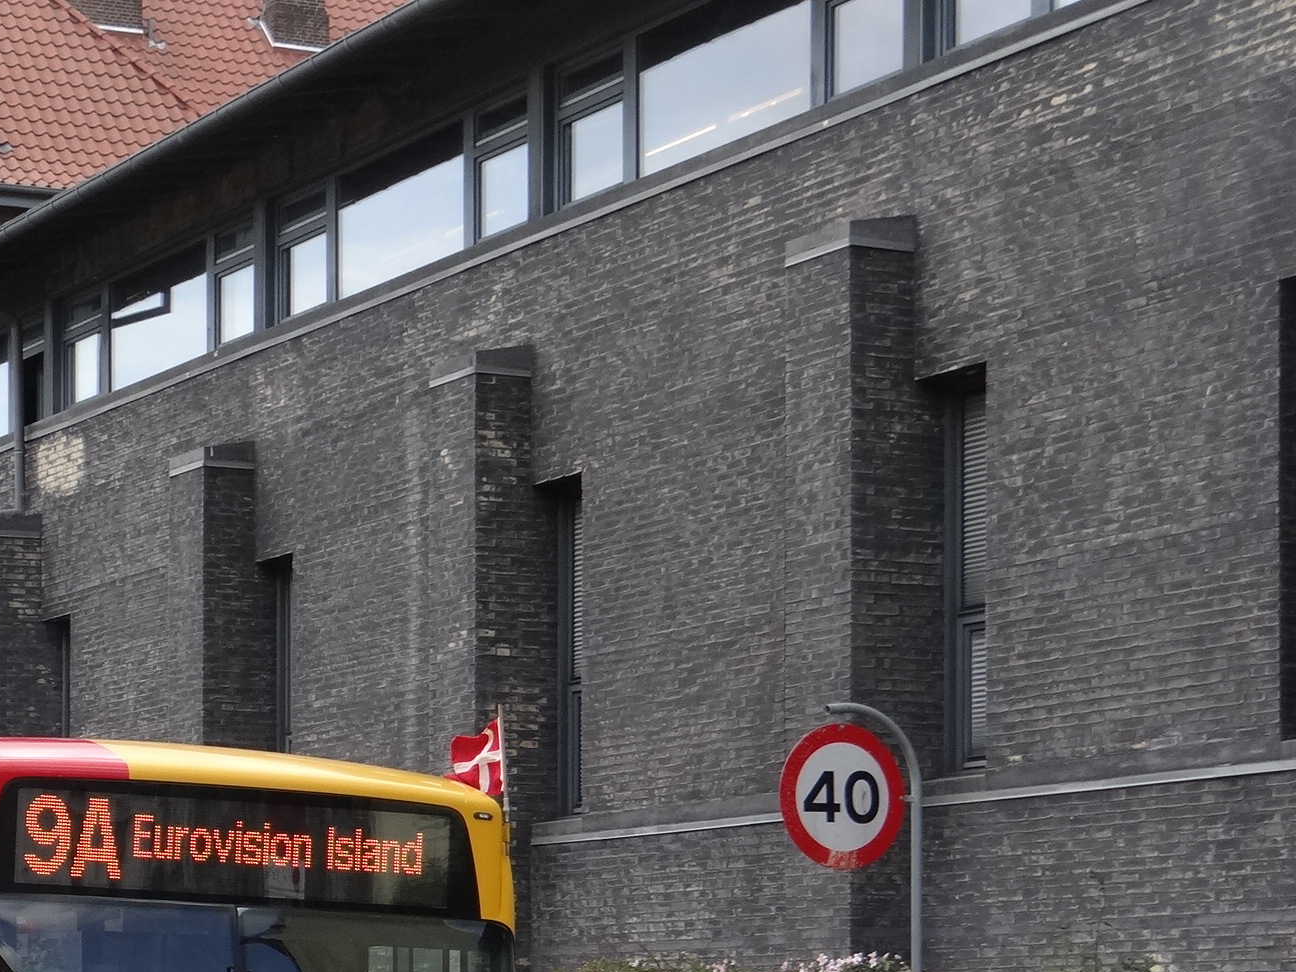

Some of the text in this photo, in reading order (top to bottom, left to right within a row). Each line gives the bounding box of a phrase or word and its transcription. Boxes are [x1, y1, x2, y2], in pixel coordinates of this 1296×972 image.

[803, 770, 880, 825] 40
[23, 793, 423, 881] 9A Eurovision Island
